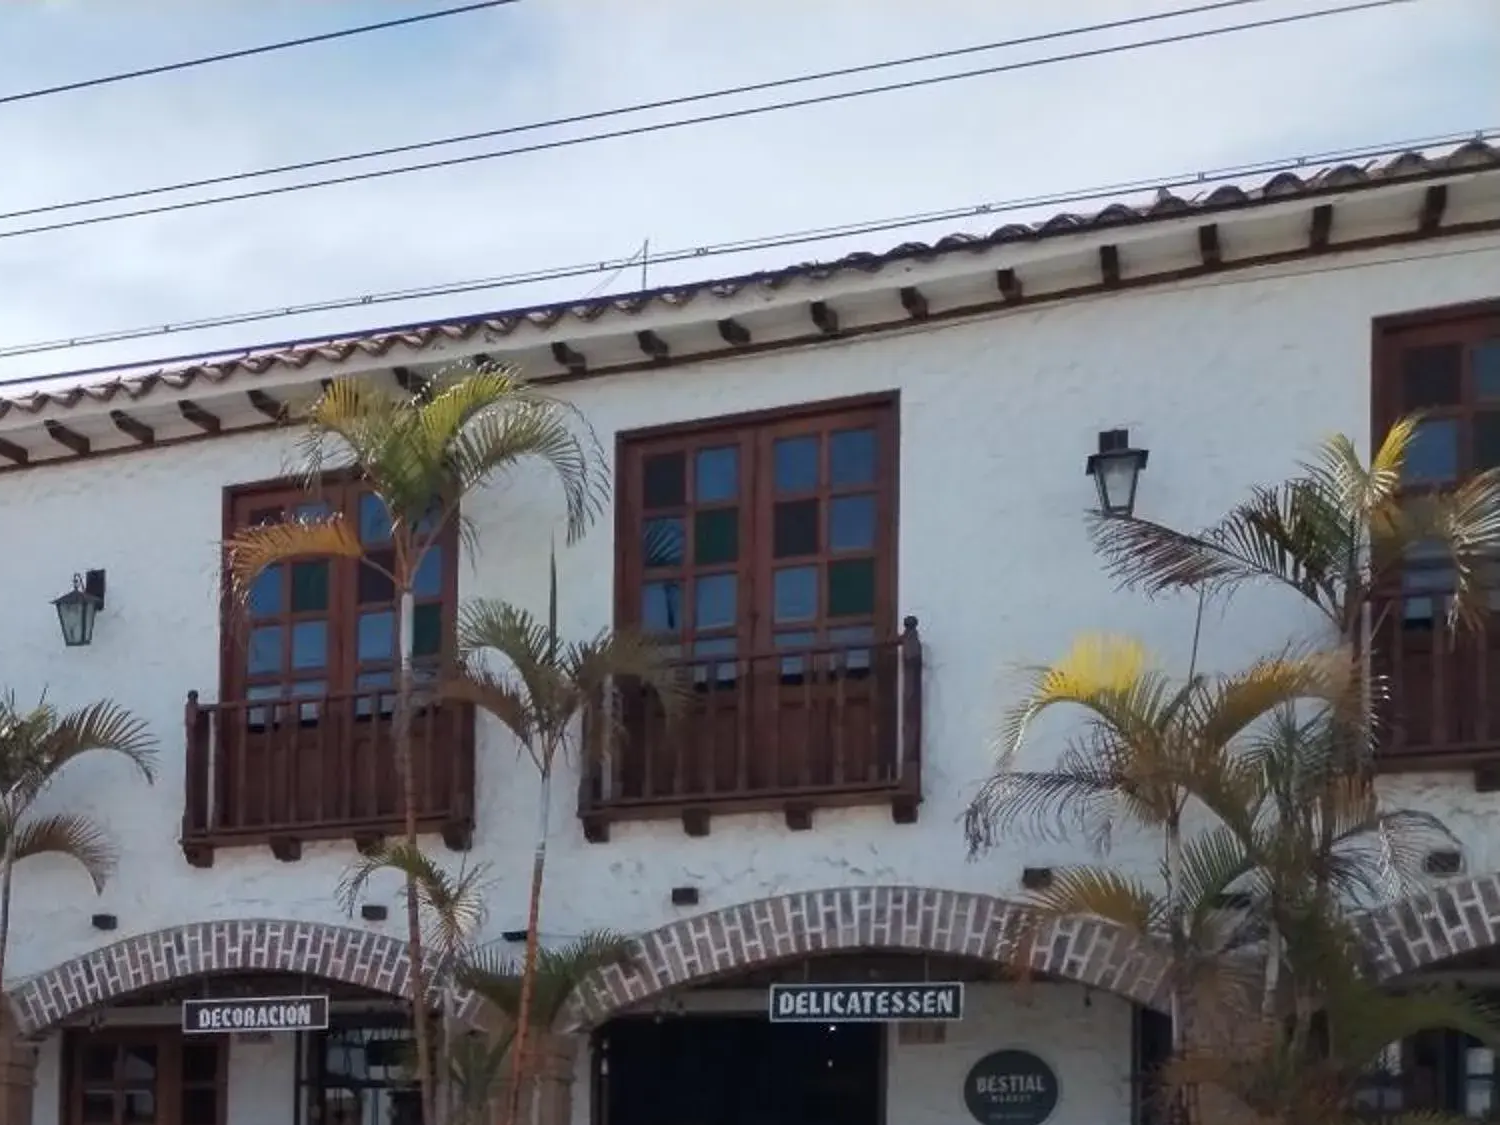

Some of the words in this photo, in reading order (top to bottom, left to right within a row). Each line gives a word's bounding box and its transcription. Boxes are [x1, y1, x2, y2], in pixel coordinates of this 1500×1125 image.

[198, 1002, 312, 1028] DECORACIÓN
[778, 989, 953, 1016] DELICATESSEN
[976, 1074, 1047, 1094] BESTIAL
